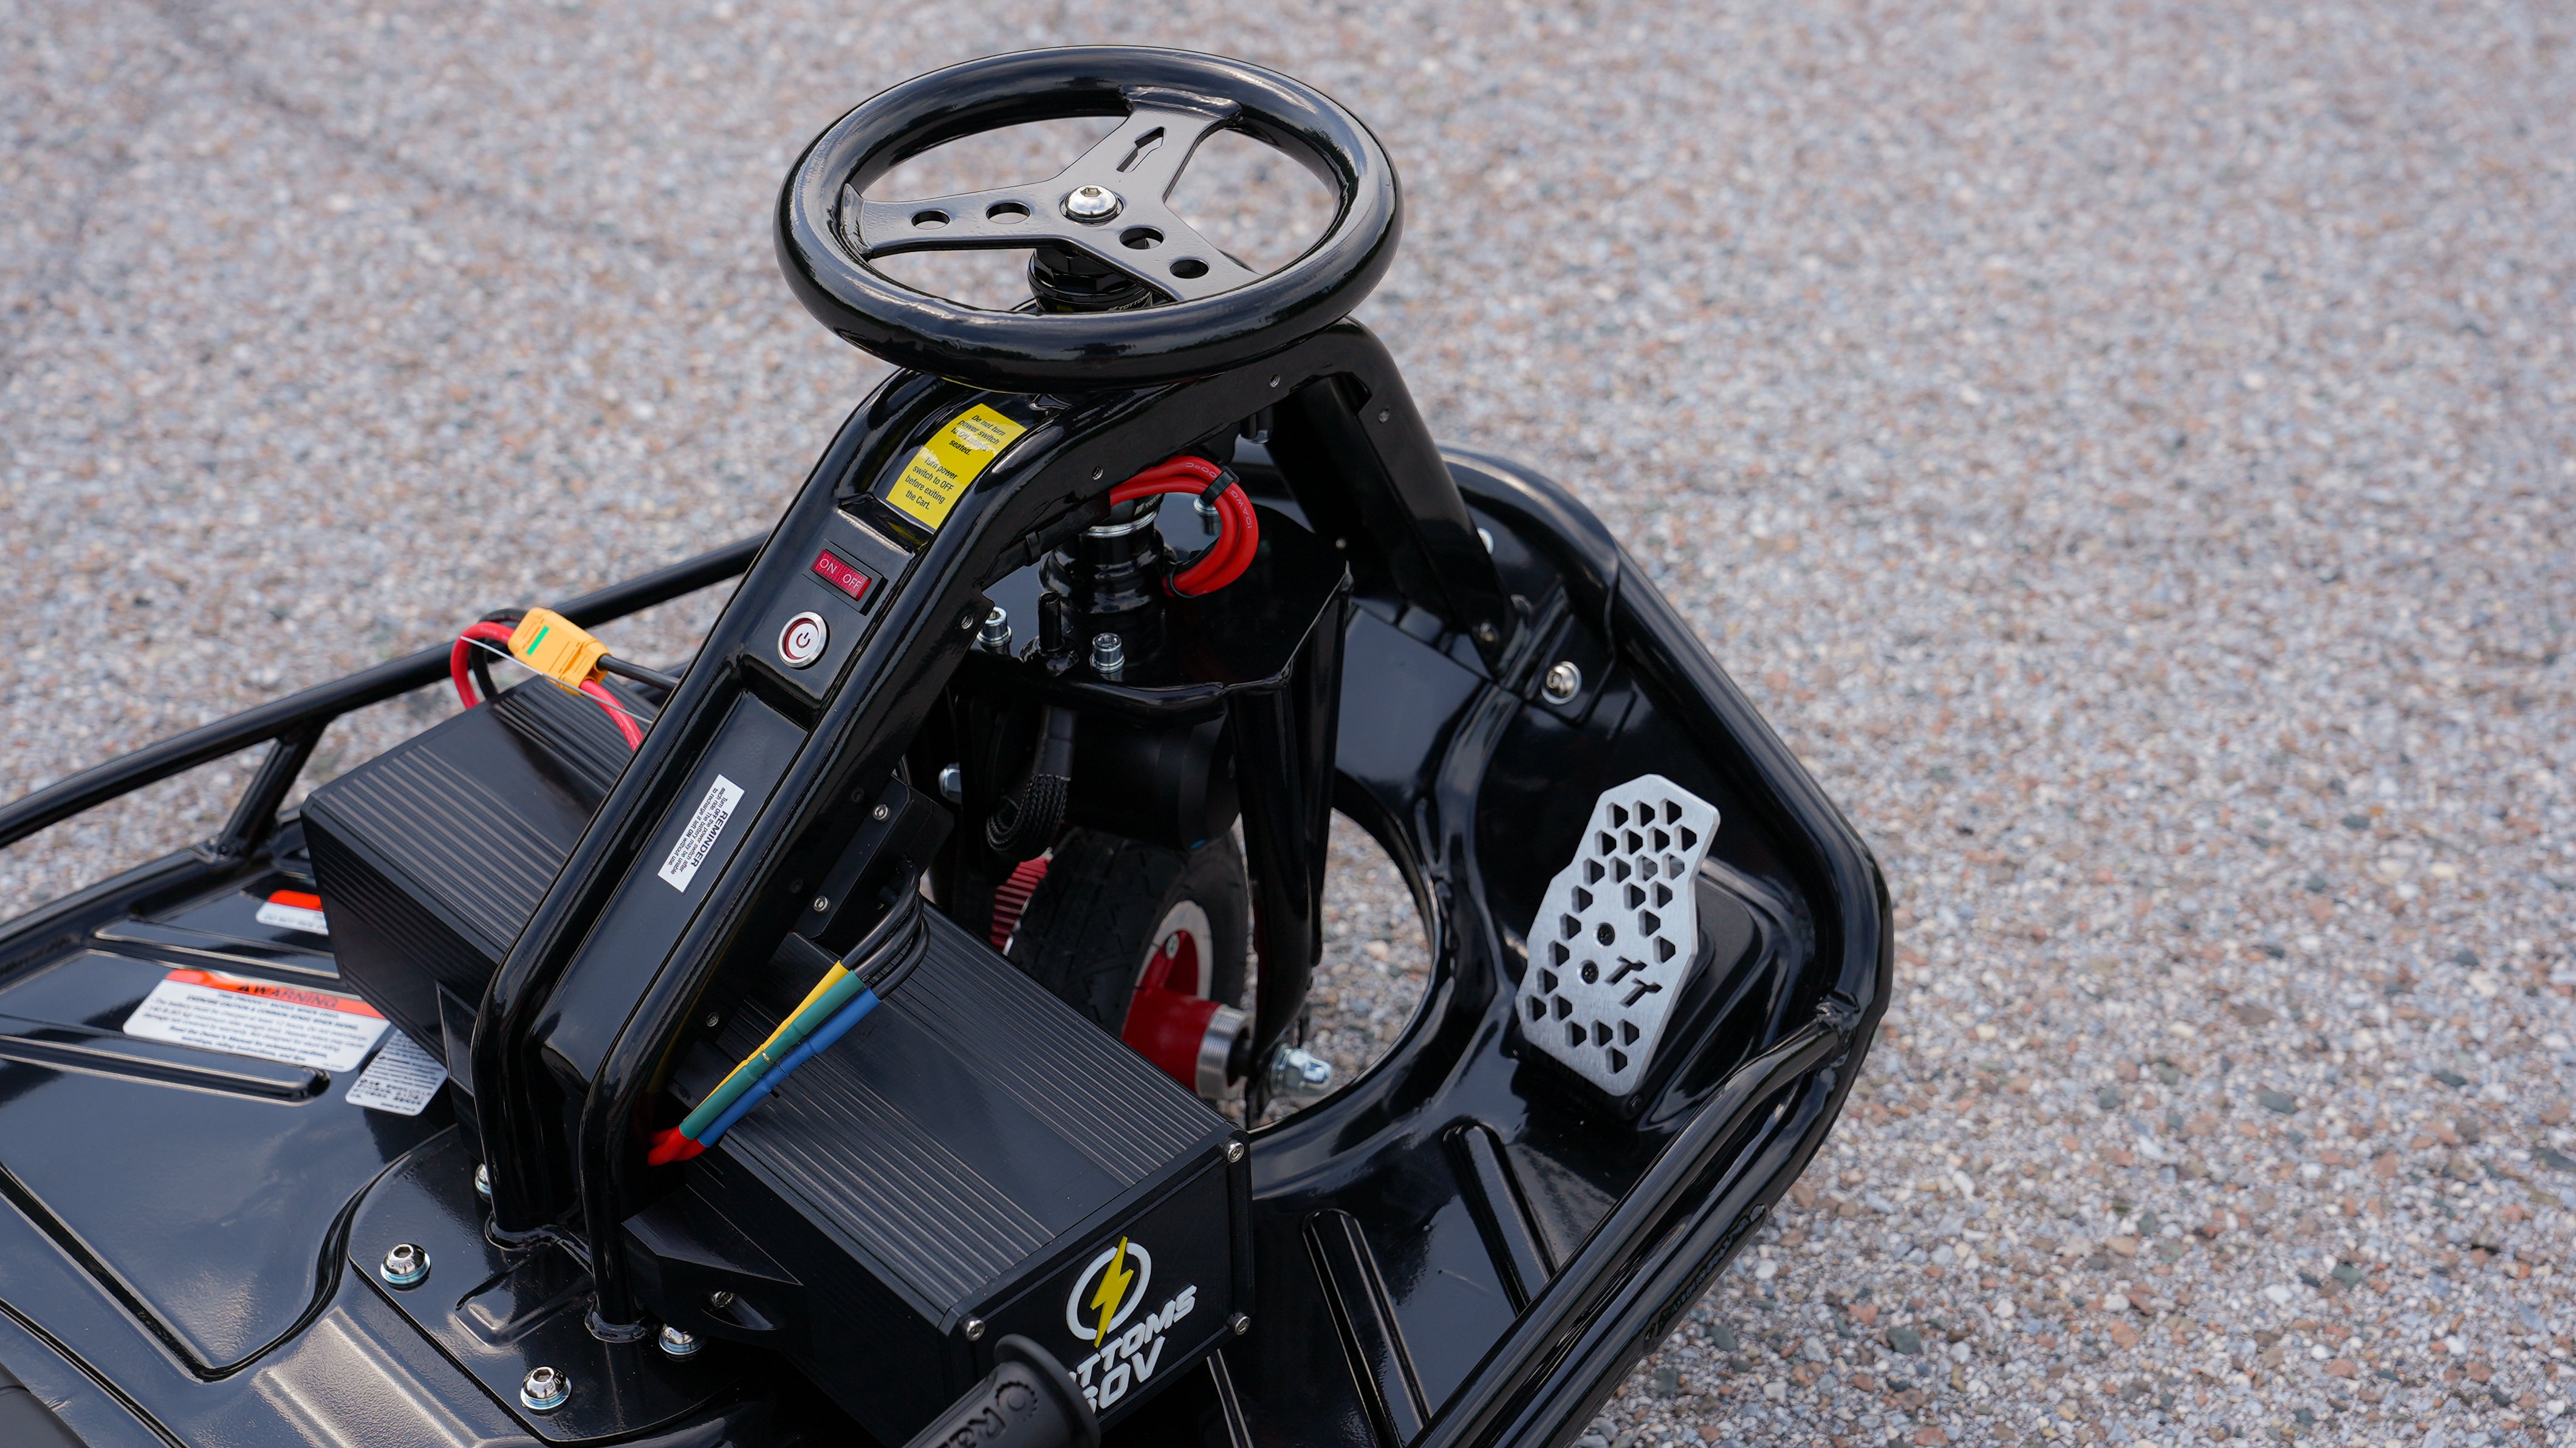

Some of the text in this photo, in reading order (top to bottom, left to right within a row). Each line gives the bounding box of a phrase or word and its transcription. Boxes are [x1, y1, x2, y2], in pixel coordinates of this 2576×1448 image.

[956, 420, 999, 445] power switch
[980, 420, 994, 429] not
[991, 426, 1006, 437] turn
[949, 440, 971, 456] seated.
[957, 431, 970, 440] ON
[967, 437, 988, 452] unless
[924, 457, 958, 480] Turn power
[1185, 462, 1218, 479] 00°C
[913, 466, 934, 481] switch
[940, 480, 954, 491] OFF
[905, 474, 946, 505] before exiting
[905, 490, 930, 510] the Cart.
[820, 558, 862, 589] ON OFF
[716, 787, 725, 800] each
[699, 793, 714, 816] recharge
[718, 797, 728, 808] Turn
[703, 812, 712, 822] The
[711, 808, 721, 820] OFF
[686, 828, 694, 838] ON
[691, 820, 699, 829] left
[692, 821, 706, 839] battery
[691, 810, 728, 867] REMINDER
[697, 827, 708, 844] power
[674, 838, 688, 856] without
[685, 839, 694, 851] may
[686, 843, 699, 860] switch
[670, 857, 683, 875] unable
[679, 859, 688, 873] after
[253, 986, 338, 1008] WARNING
